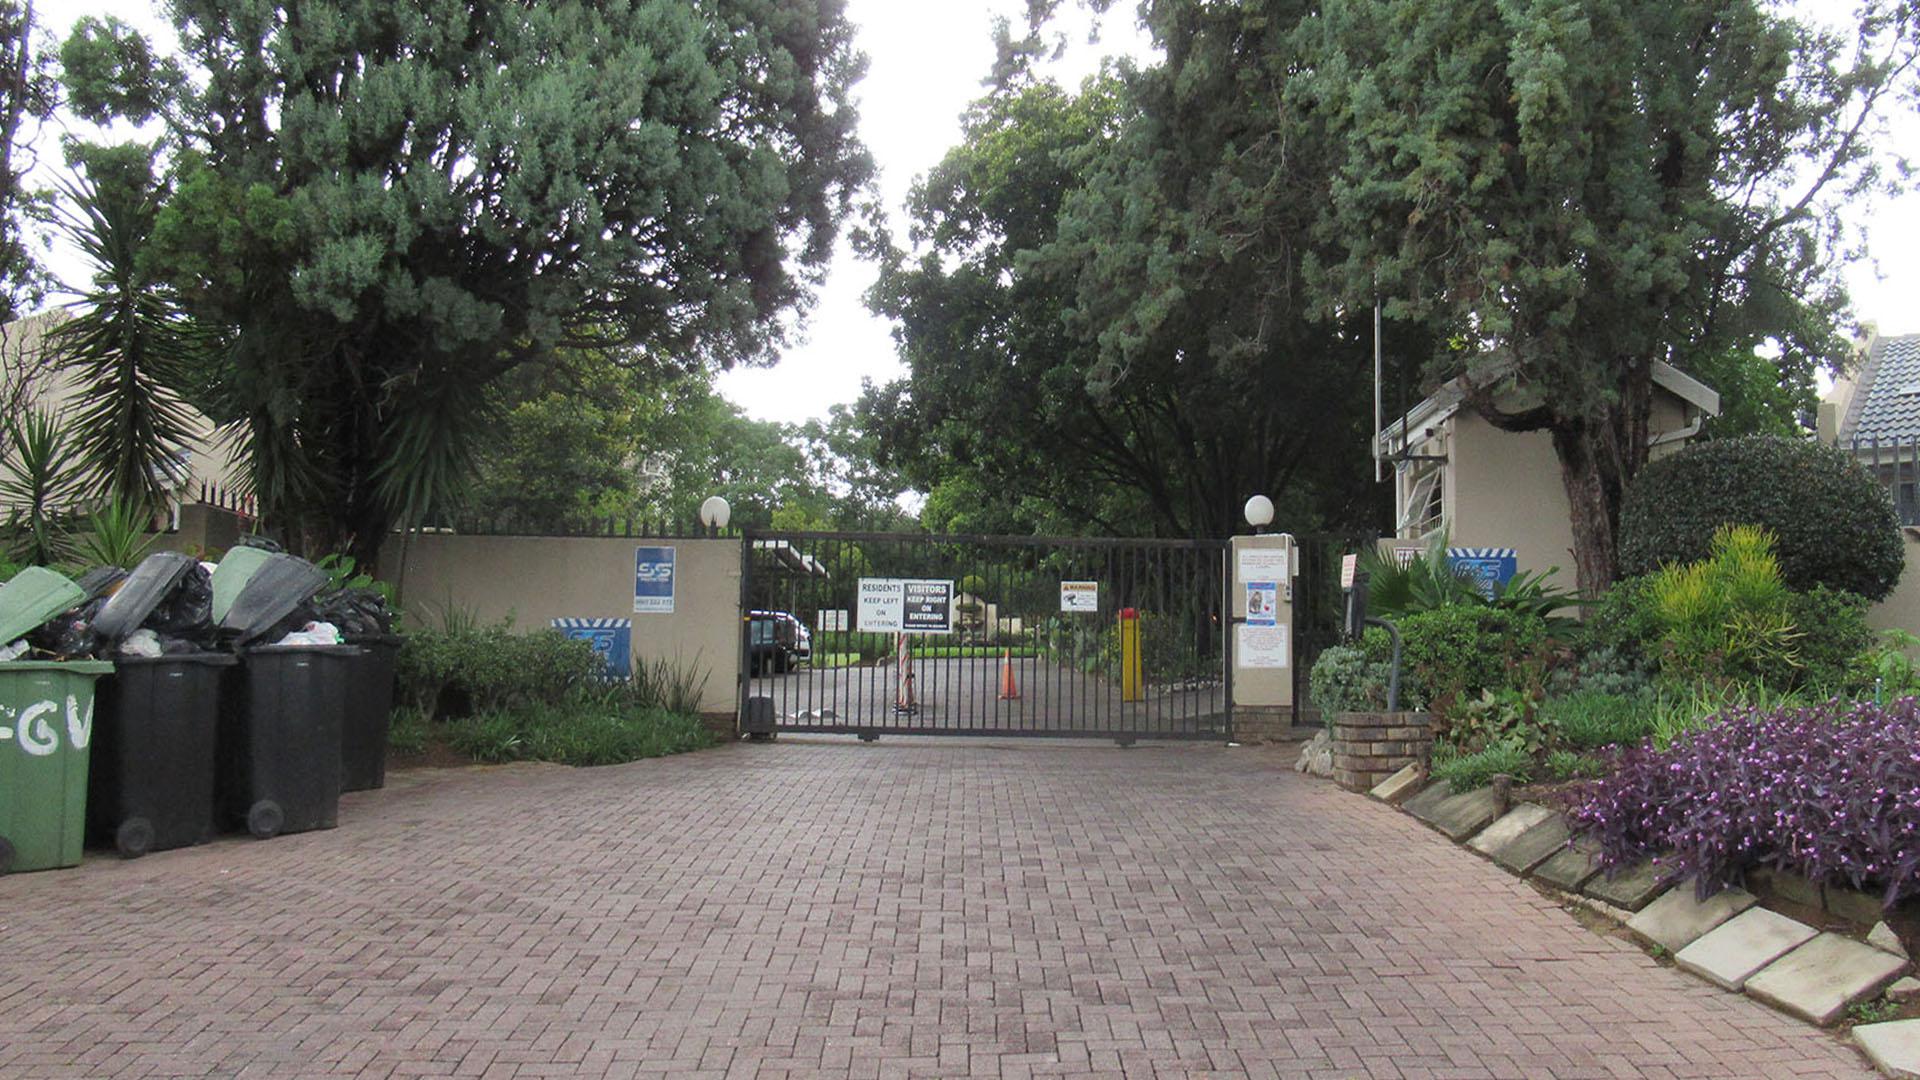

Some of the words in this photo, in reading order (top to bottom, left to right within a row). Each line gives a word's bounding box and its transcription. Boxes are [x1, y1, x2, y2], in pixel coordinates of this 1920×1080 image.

[862, 583, 901, 592] RESIDENTS
[907, 585, 947, 594] VISITORS
[863, 597, 881, 605] KEEP
[882, 597, 899, 605] LEFT
[907, 596, 925, 604] KEEP
[925, 596, 947, 604] RIGHT
[909, 613, 944, 621] ENTERING
